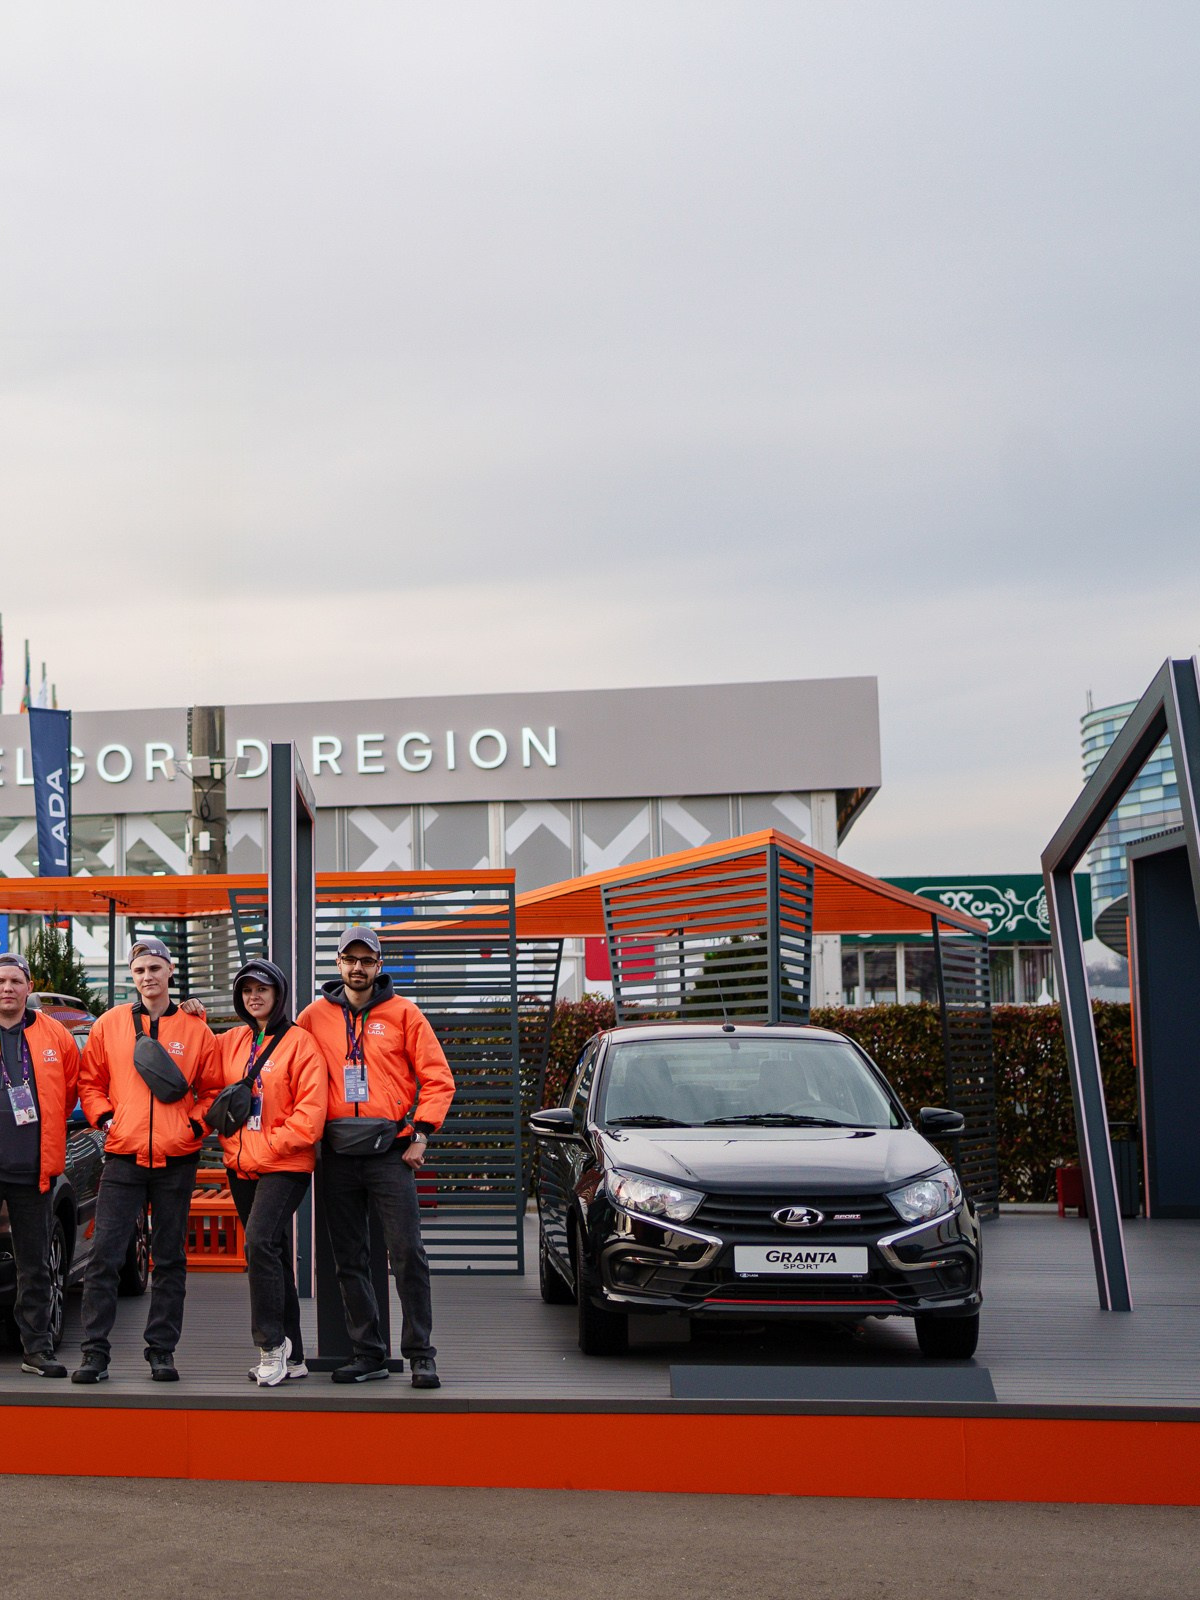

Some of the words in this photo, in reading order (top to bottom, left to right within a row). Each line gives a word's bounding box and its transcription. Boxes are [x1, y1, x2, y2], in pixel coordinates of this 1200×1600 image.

[311, 726, 558, 776] REGION
[46, 768, 68, 867] LADA
[167, 1048, 184, 1056] LADA
[765, 1250, 837, 1263] GRANTA
